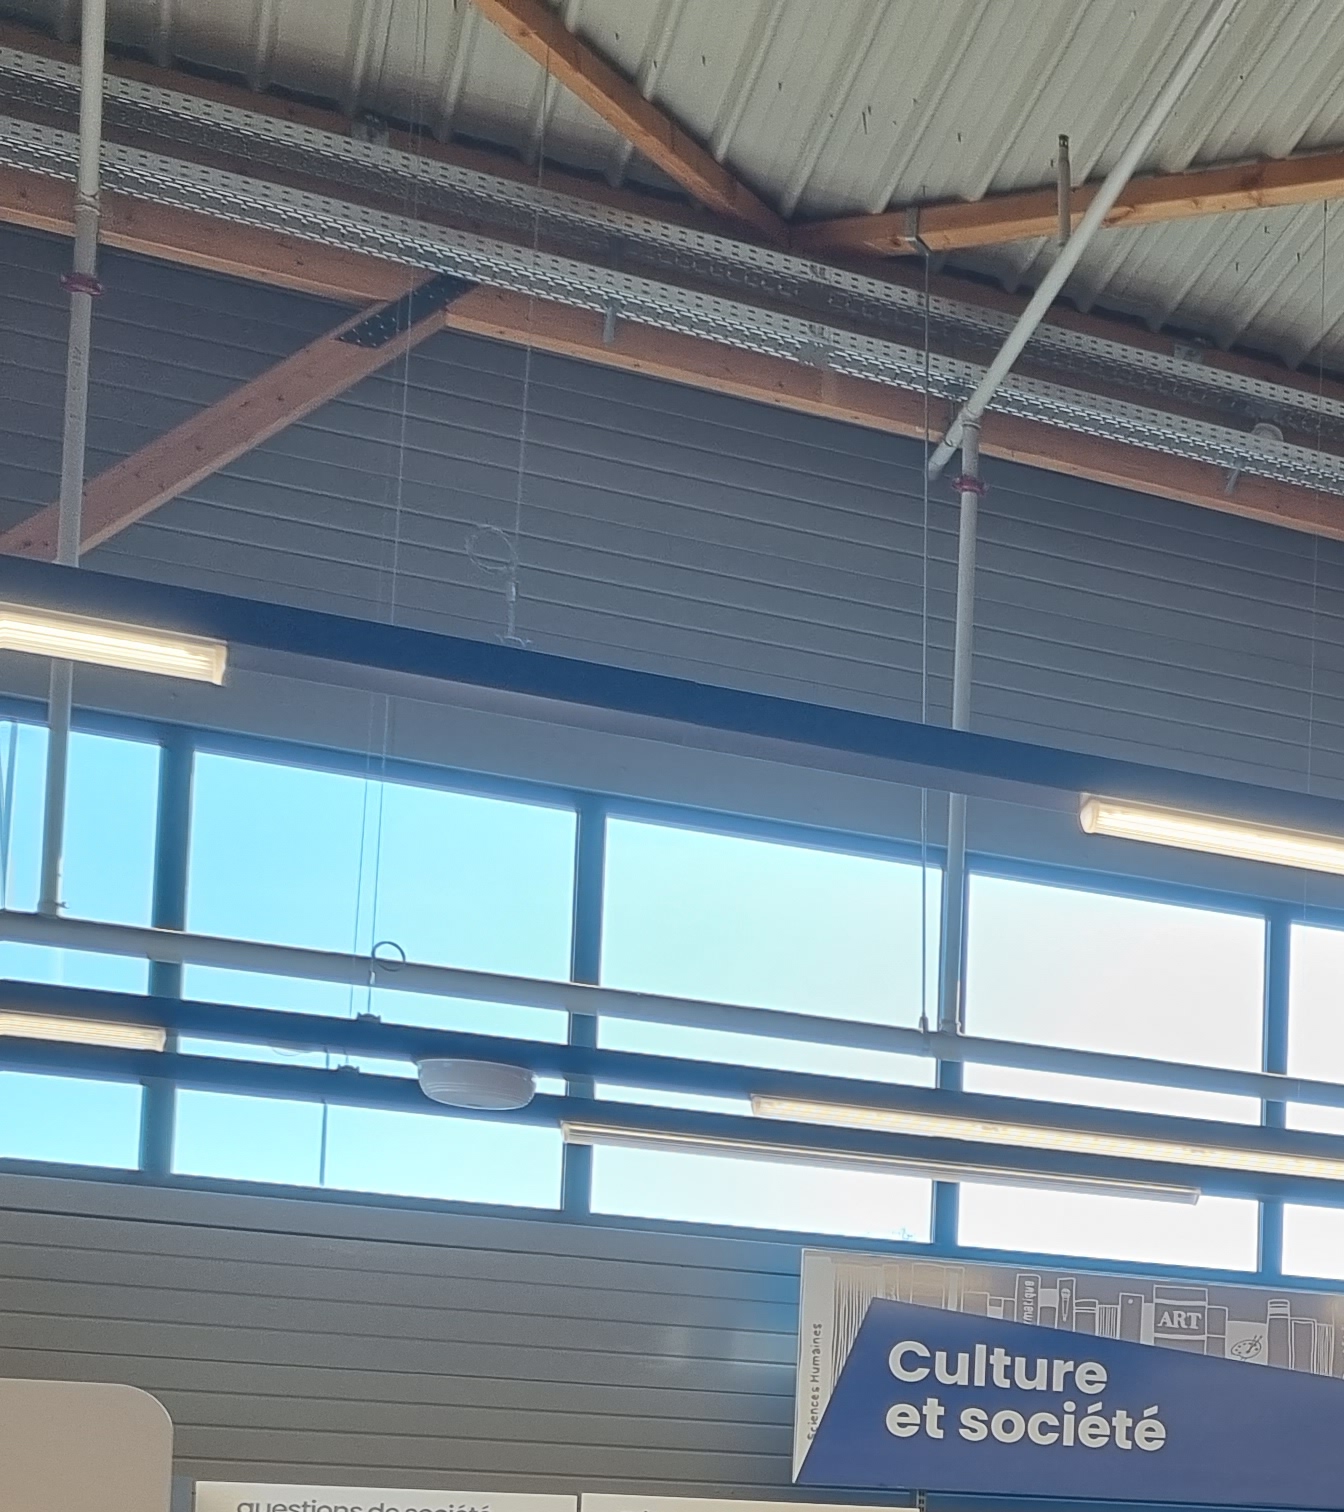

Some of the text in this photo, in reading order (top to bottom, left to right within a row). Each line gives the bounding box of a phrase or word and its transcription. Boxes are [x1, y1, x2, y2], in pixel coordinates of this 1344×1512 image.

[1157, 1310, 1203, 1331] ART
[888, 1340, 1108, 1395] Culture
[885, 1397, 1167, 1452] et société
